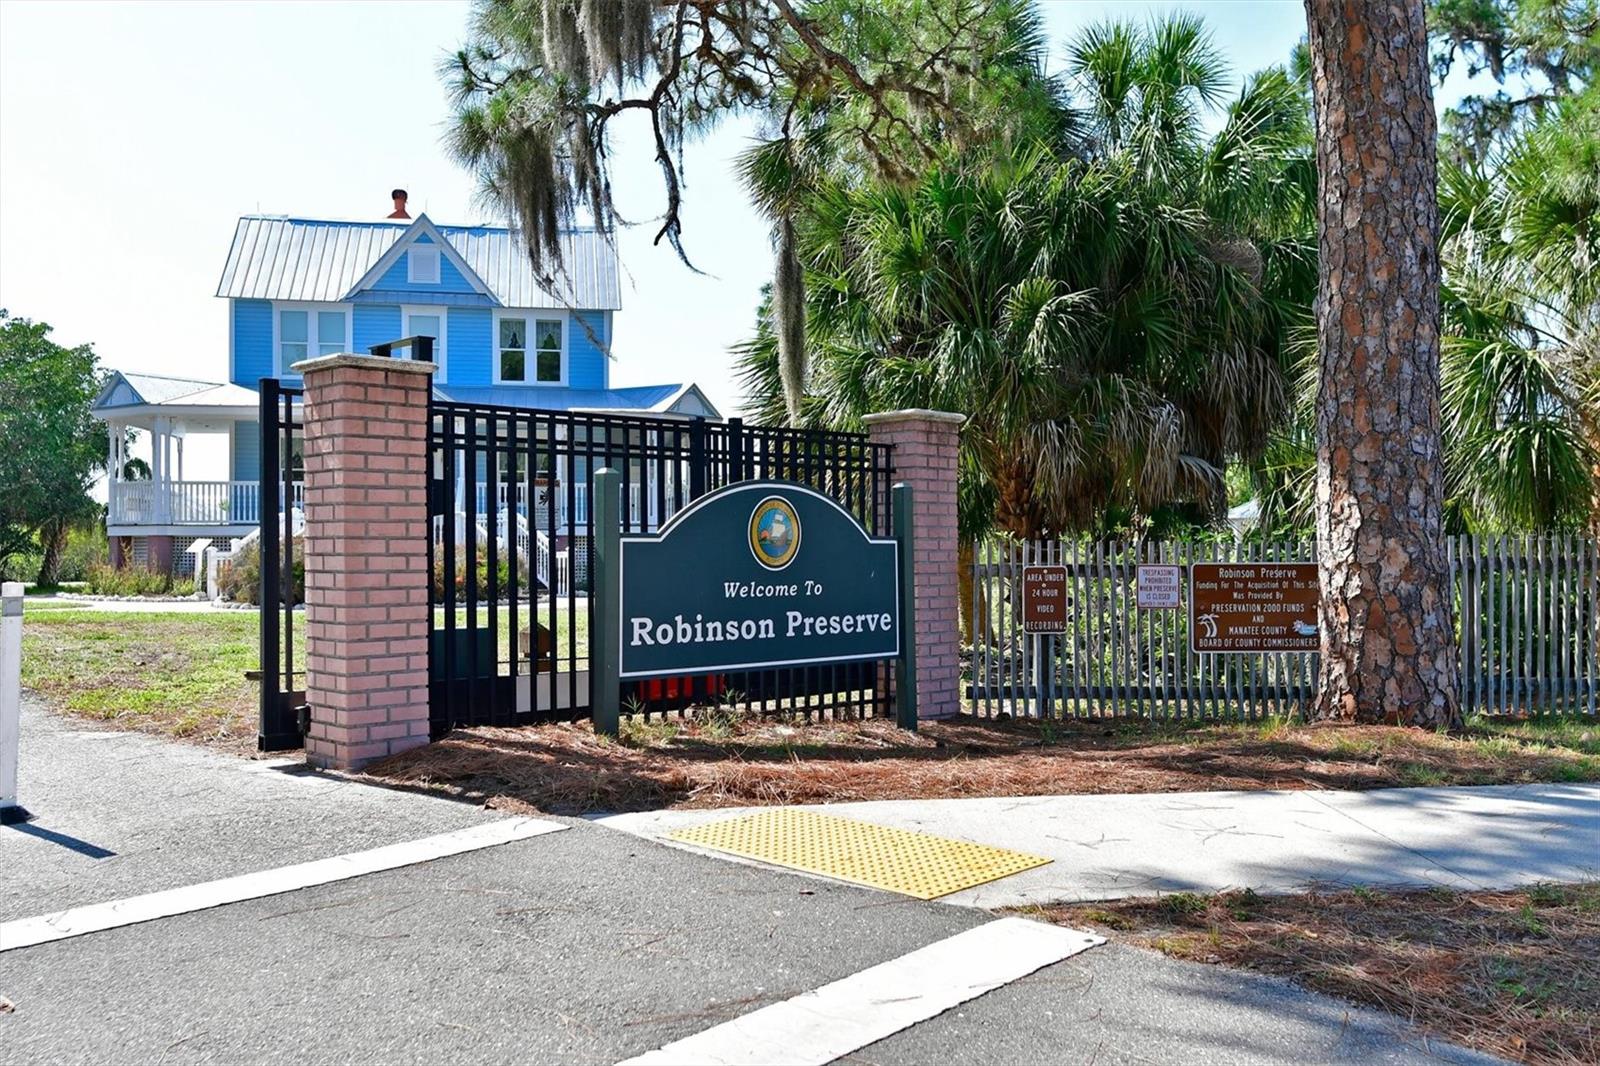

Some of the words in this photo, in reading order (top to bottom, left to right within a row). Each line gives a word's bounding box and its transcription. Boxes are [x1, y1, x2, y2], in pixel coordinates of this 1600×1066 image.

[1027, 573, 1042, 581] AREA
[1044, 573, 1064, 581] UNDER
[1219, 567, 1255, 578] Robinson
[1261, 567, 1297, 578] Preserve
[723, 582, 798, 598] Welcome
[804, 580, 823, 595] To
[1196, 581, 1217, 590] Funding
[1248, 581, 1279, 590] Acquisition
[1282, 580, 1289, 588] Of
[1293, 580, 1305, 588] This
[1032, 589, 1040, 597] 24
[1042, 589, 1058, 597] HOUR
[1276, 592, 1283, 600] By
[1211, 604, 1261, 613] PRESERVATION
[1263, 604, 1281, 613] 2000
[1283, 604, 1305, 613] FUNDS
[1252, 615, 1265, 623] AND
[630, 613, 775, 646] Robinson
[785, 610, 892, 637] Preserve
[1228, 626, 1259, 635] MANATEE
[1261, 626, 1287, 635] COUNTY
[1199, 638, 1222, 648] BOARD
[1224, 638, 1232, 647] OF
[1234, 638, 1260, 647] COUNTY
[1263, 638, 1318, 647] COMMISSIONERS
